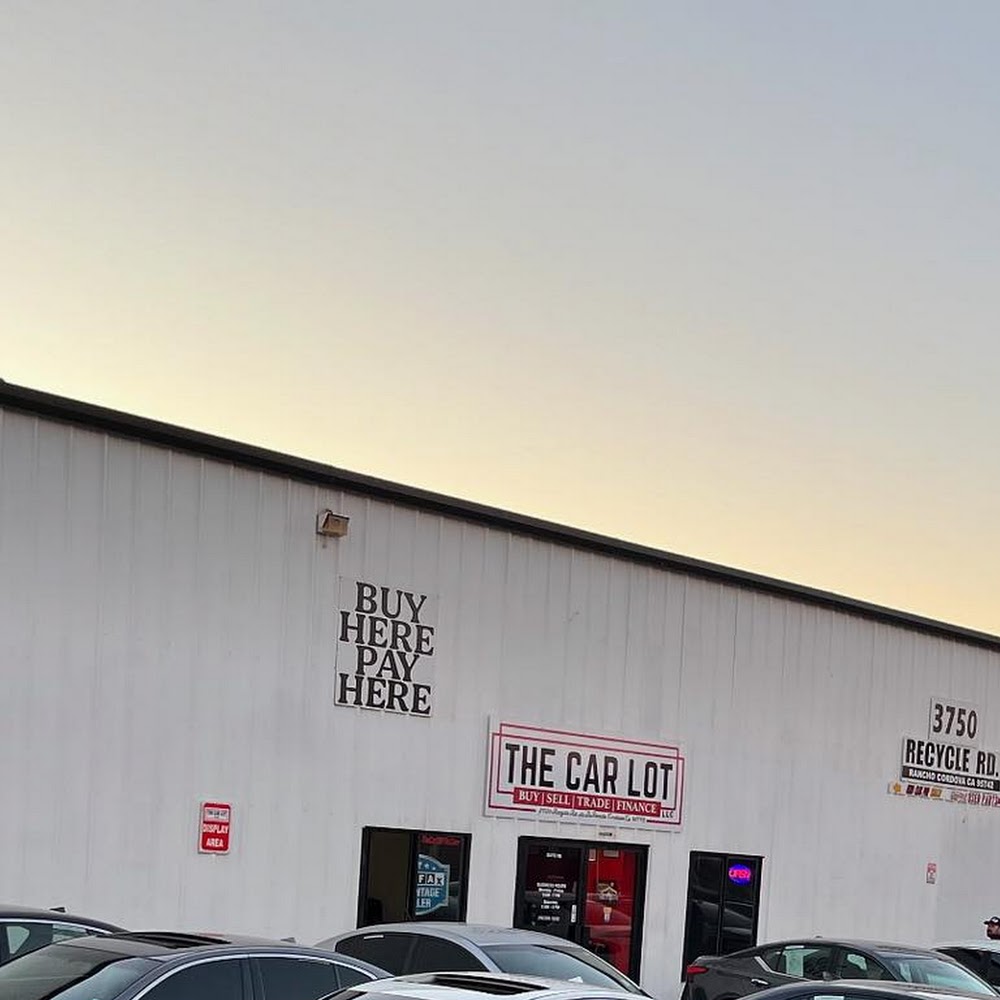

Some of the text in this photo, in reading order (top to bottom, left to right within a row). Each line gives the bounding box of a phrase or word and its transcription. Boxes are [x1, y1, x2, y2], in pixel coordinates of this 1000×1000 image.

[355, 581, 427, 623] BUY
[339, 611, 434, 656] HERE
[356, 645, 420, 682] PAY
[338, 673, 431, 715] HERE
[933, 703, 977, 739] 3750
[505, 743, 673, 800] THE CAR LOT
[905, 739, 999, 777] RECYCLE RD.
[908, 769, 936, 780] RANCHO
[937, 773, 966, 785] CORDOVA
[966, 778, 976, 787] CA
[518, 789, 541, 803] BUY
[546, 792, 571, 806] SELL
[577, 795, 611, 810] TRADE
[616, 800, 658, 814] FINANCE
[661, 810, 674, 818] LLC
[203, 823, 229, 834] DISPLAY
[205, 838, 224, 848] AREA
[418, 873, 445, 886] FAX
[416, 898, 432, 908] LER
